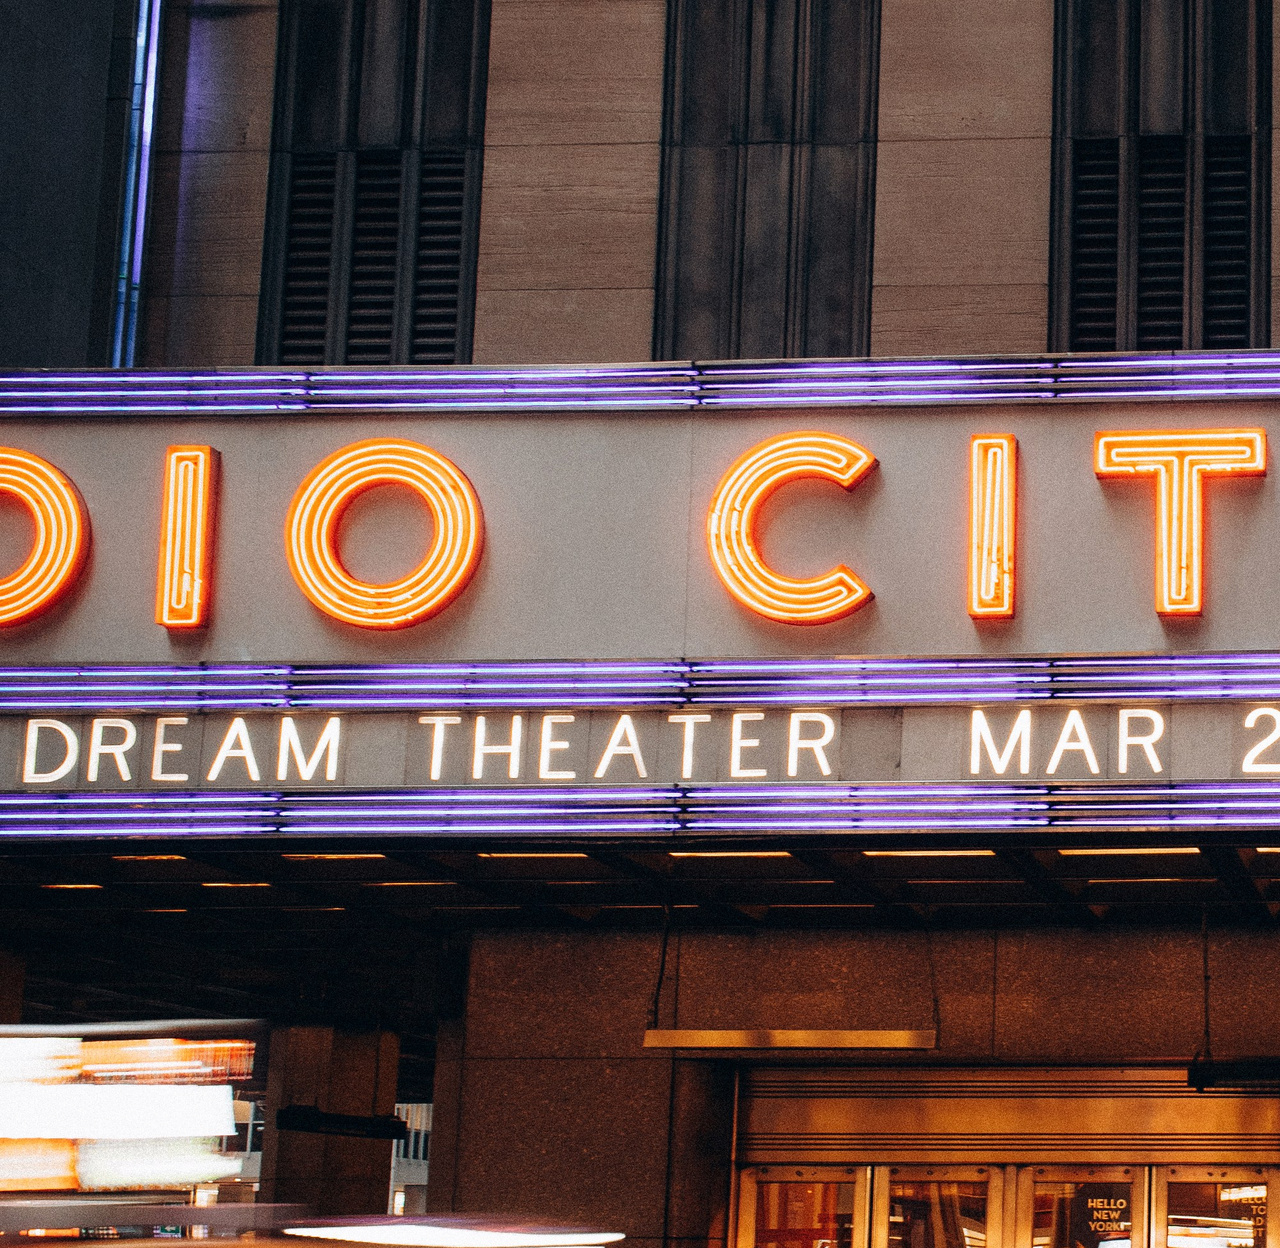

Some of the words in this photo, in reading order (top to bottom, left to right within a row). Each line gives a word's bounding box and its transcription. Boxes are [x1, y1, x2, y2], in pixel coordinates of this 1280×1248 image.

[22, 714, 342, 784] DREAM
[418, 712, 838, 781] THEATER
[969, 708, 1166, 775] MAR
[1087, 1198, 1127, 1209] HELLO
[1093, 1210, 1121, 1220] NEW
